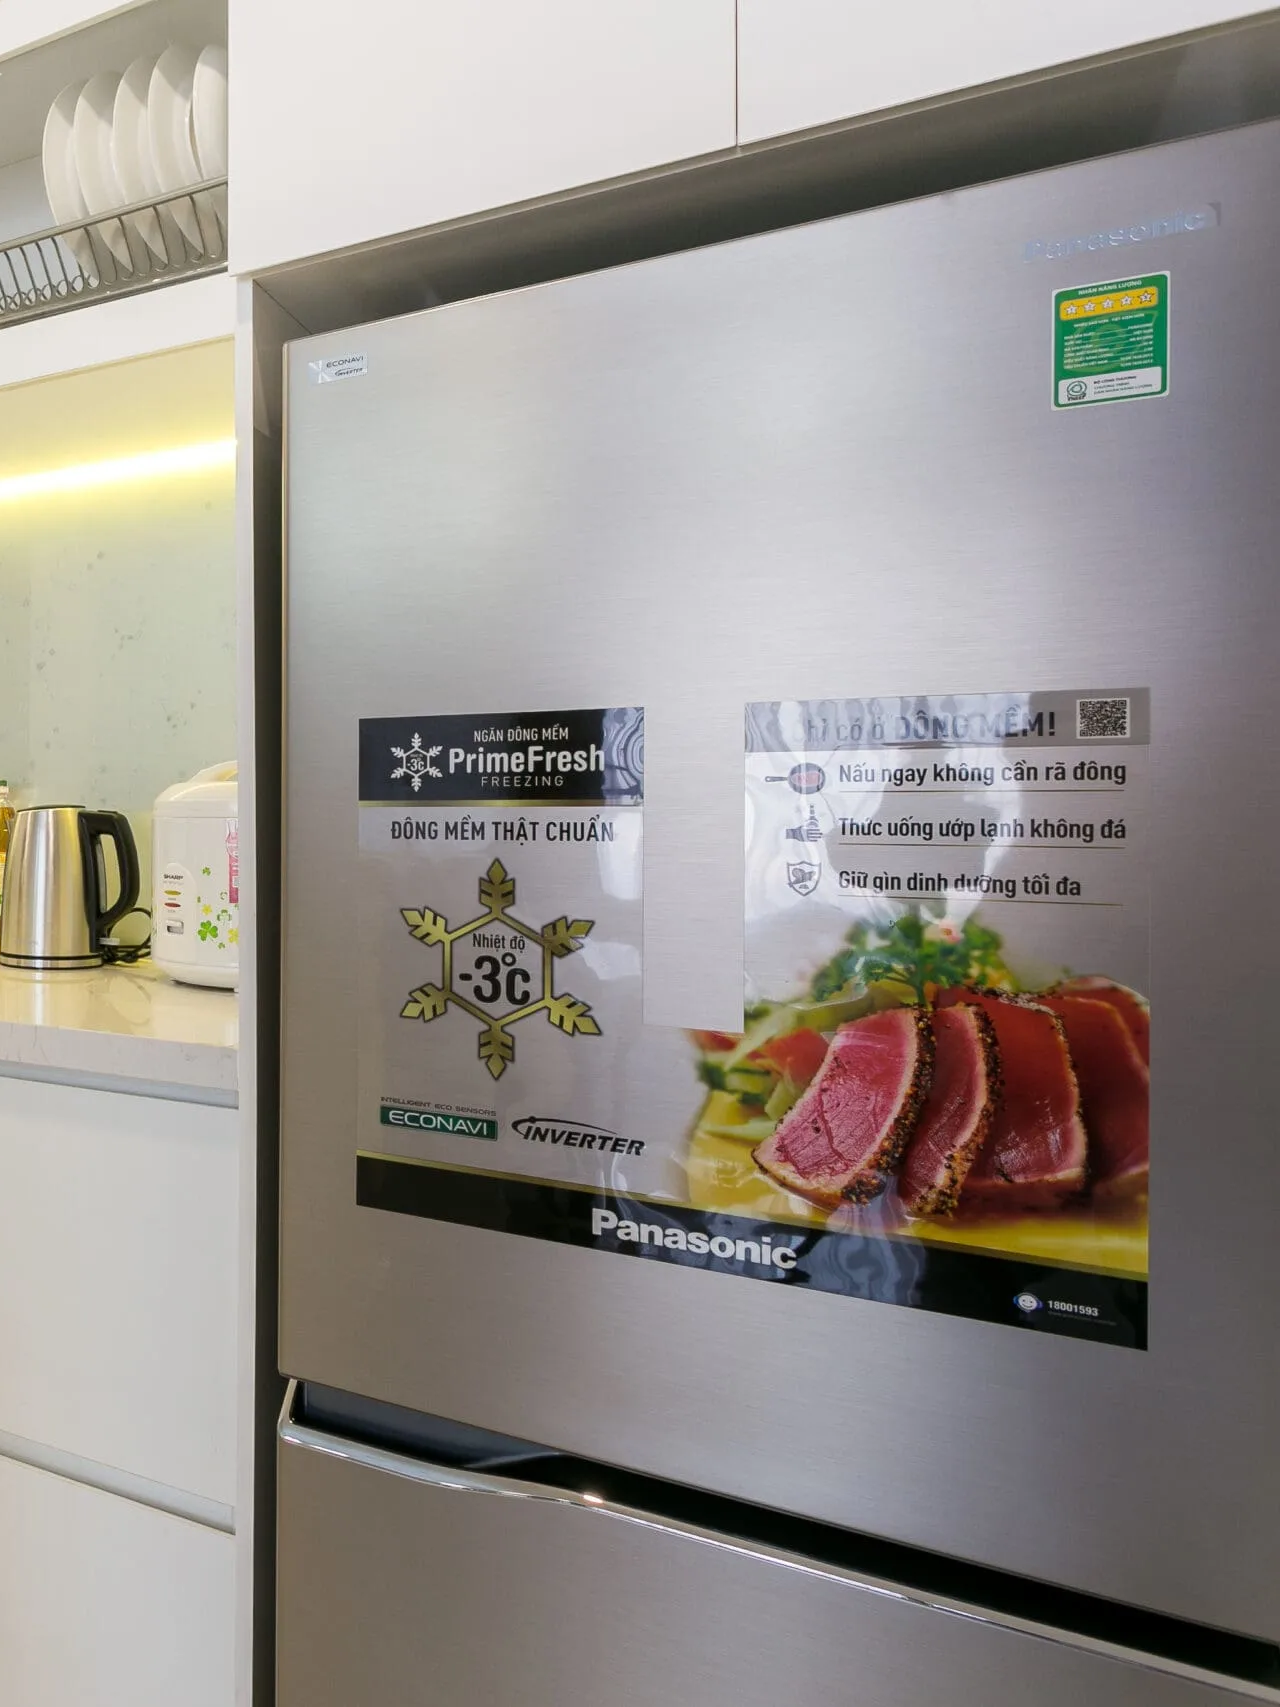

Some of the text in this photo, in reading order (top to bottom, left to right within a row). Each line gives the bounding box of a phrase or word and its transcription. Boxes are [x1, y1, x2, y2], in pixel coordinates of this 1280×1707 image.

[326, 356, 364, 368] ECONAVI
[473, 727, 504, 742] NGĂN
[507, 726, 538, 741] ĐÔNG
[449, 743, 605, 774] PrimeFresh
[481, 775, 564, 787] FREEZING
[839, 760, 1126, 786] Nấu ngay không cần rã đông
[390, 815, 614, 845] ĐÔNG MỀM THẬT CHUẨN
[839, 816, 1126, 843] Thức uống ướp lạnh không đá
[839, 871, 1081, 898] Giữ gìn dinh dưỡng tối đa
[472, 933, 526, 953] Nhiệt độ
[380, 1097, 431, 1108] INTELLIGENT
[455, 1106, 497, 1116] SENSORS
[388, 1110, 487, 1135] ECONAVI
[523, 1125, 645, 1156] INVERTER
[592, 1208, 798, 1269] Panasonic
[1047, 1300, 1099, 1316] 18001593
